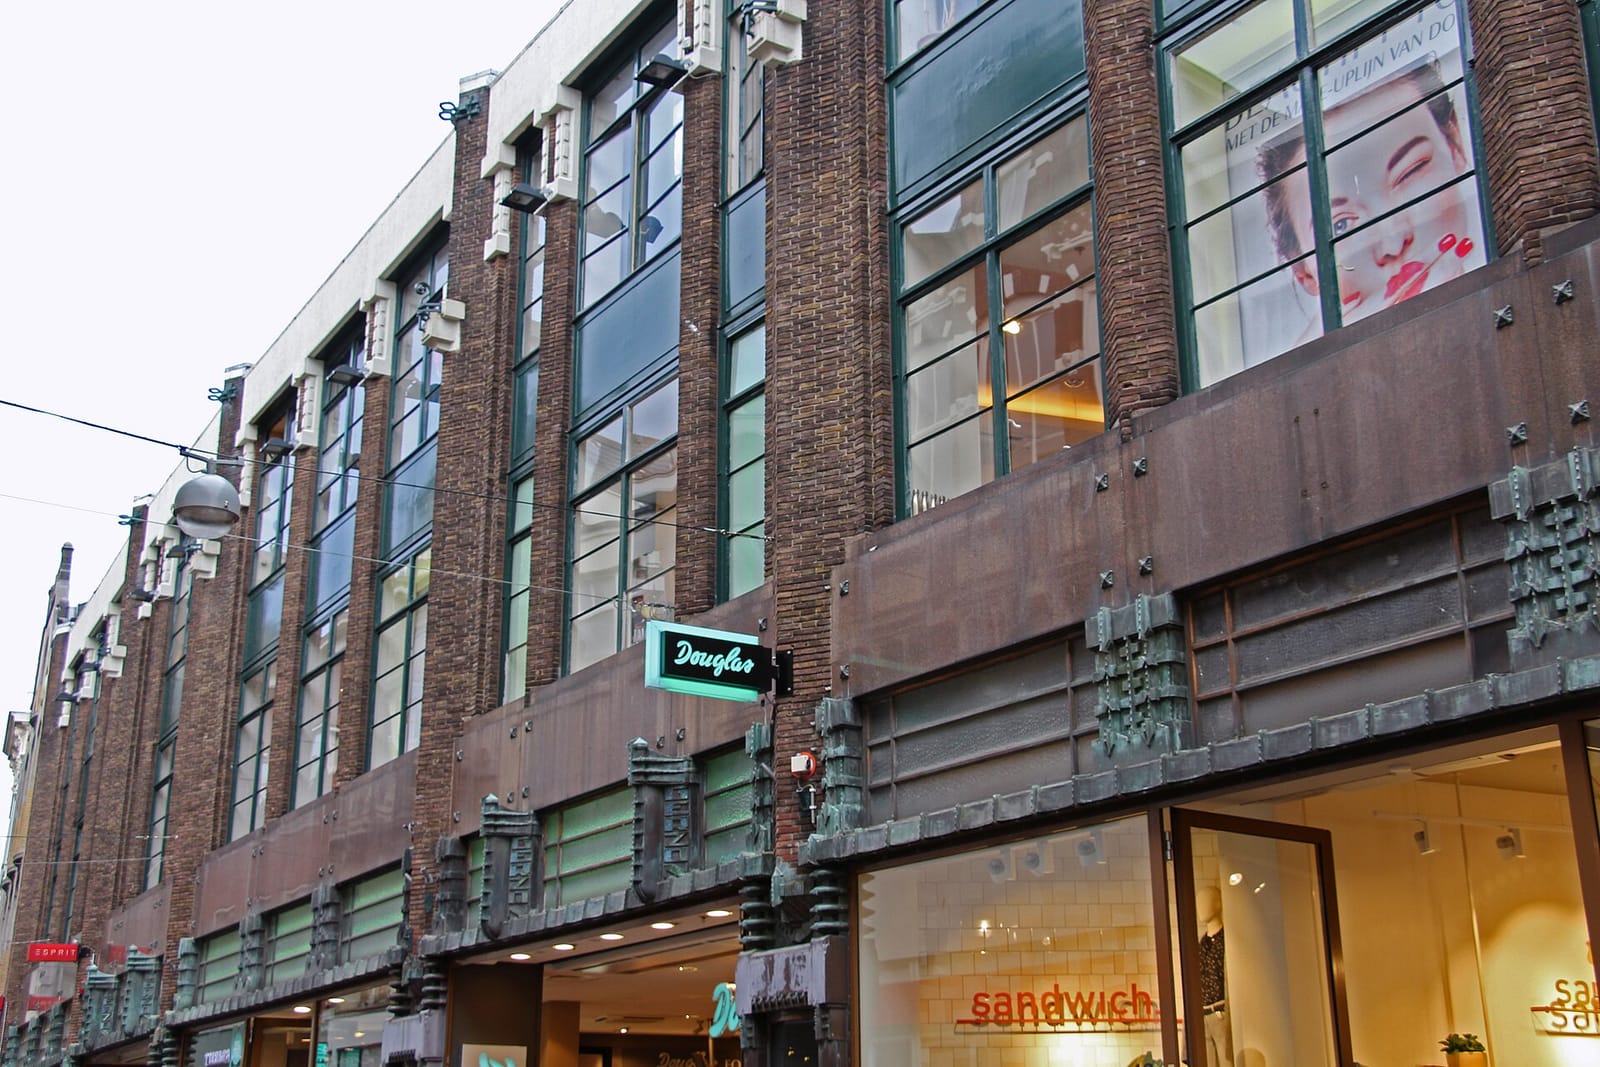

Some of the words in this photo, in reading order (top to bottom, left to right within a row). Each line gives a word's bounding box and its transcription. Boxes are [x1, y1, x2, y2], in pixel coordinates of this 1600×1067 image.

[1226, 122, 1256, 153] MET
[1261, 111, 1280, 134] DE
[1390, 31, 1424, 61] VAN
[674, 640, 755, 677] Douglas
[35, 948, 76, 957] ESPRIT
